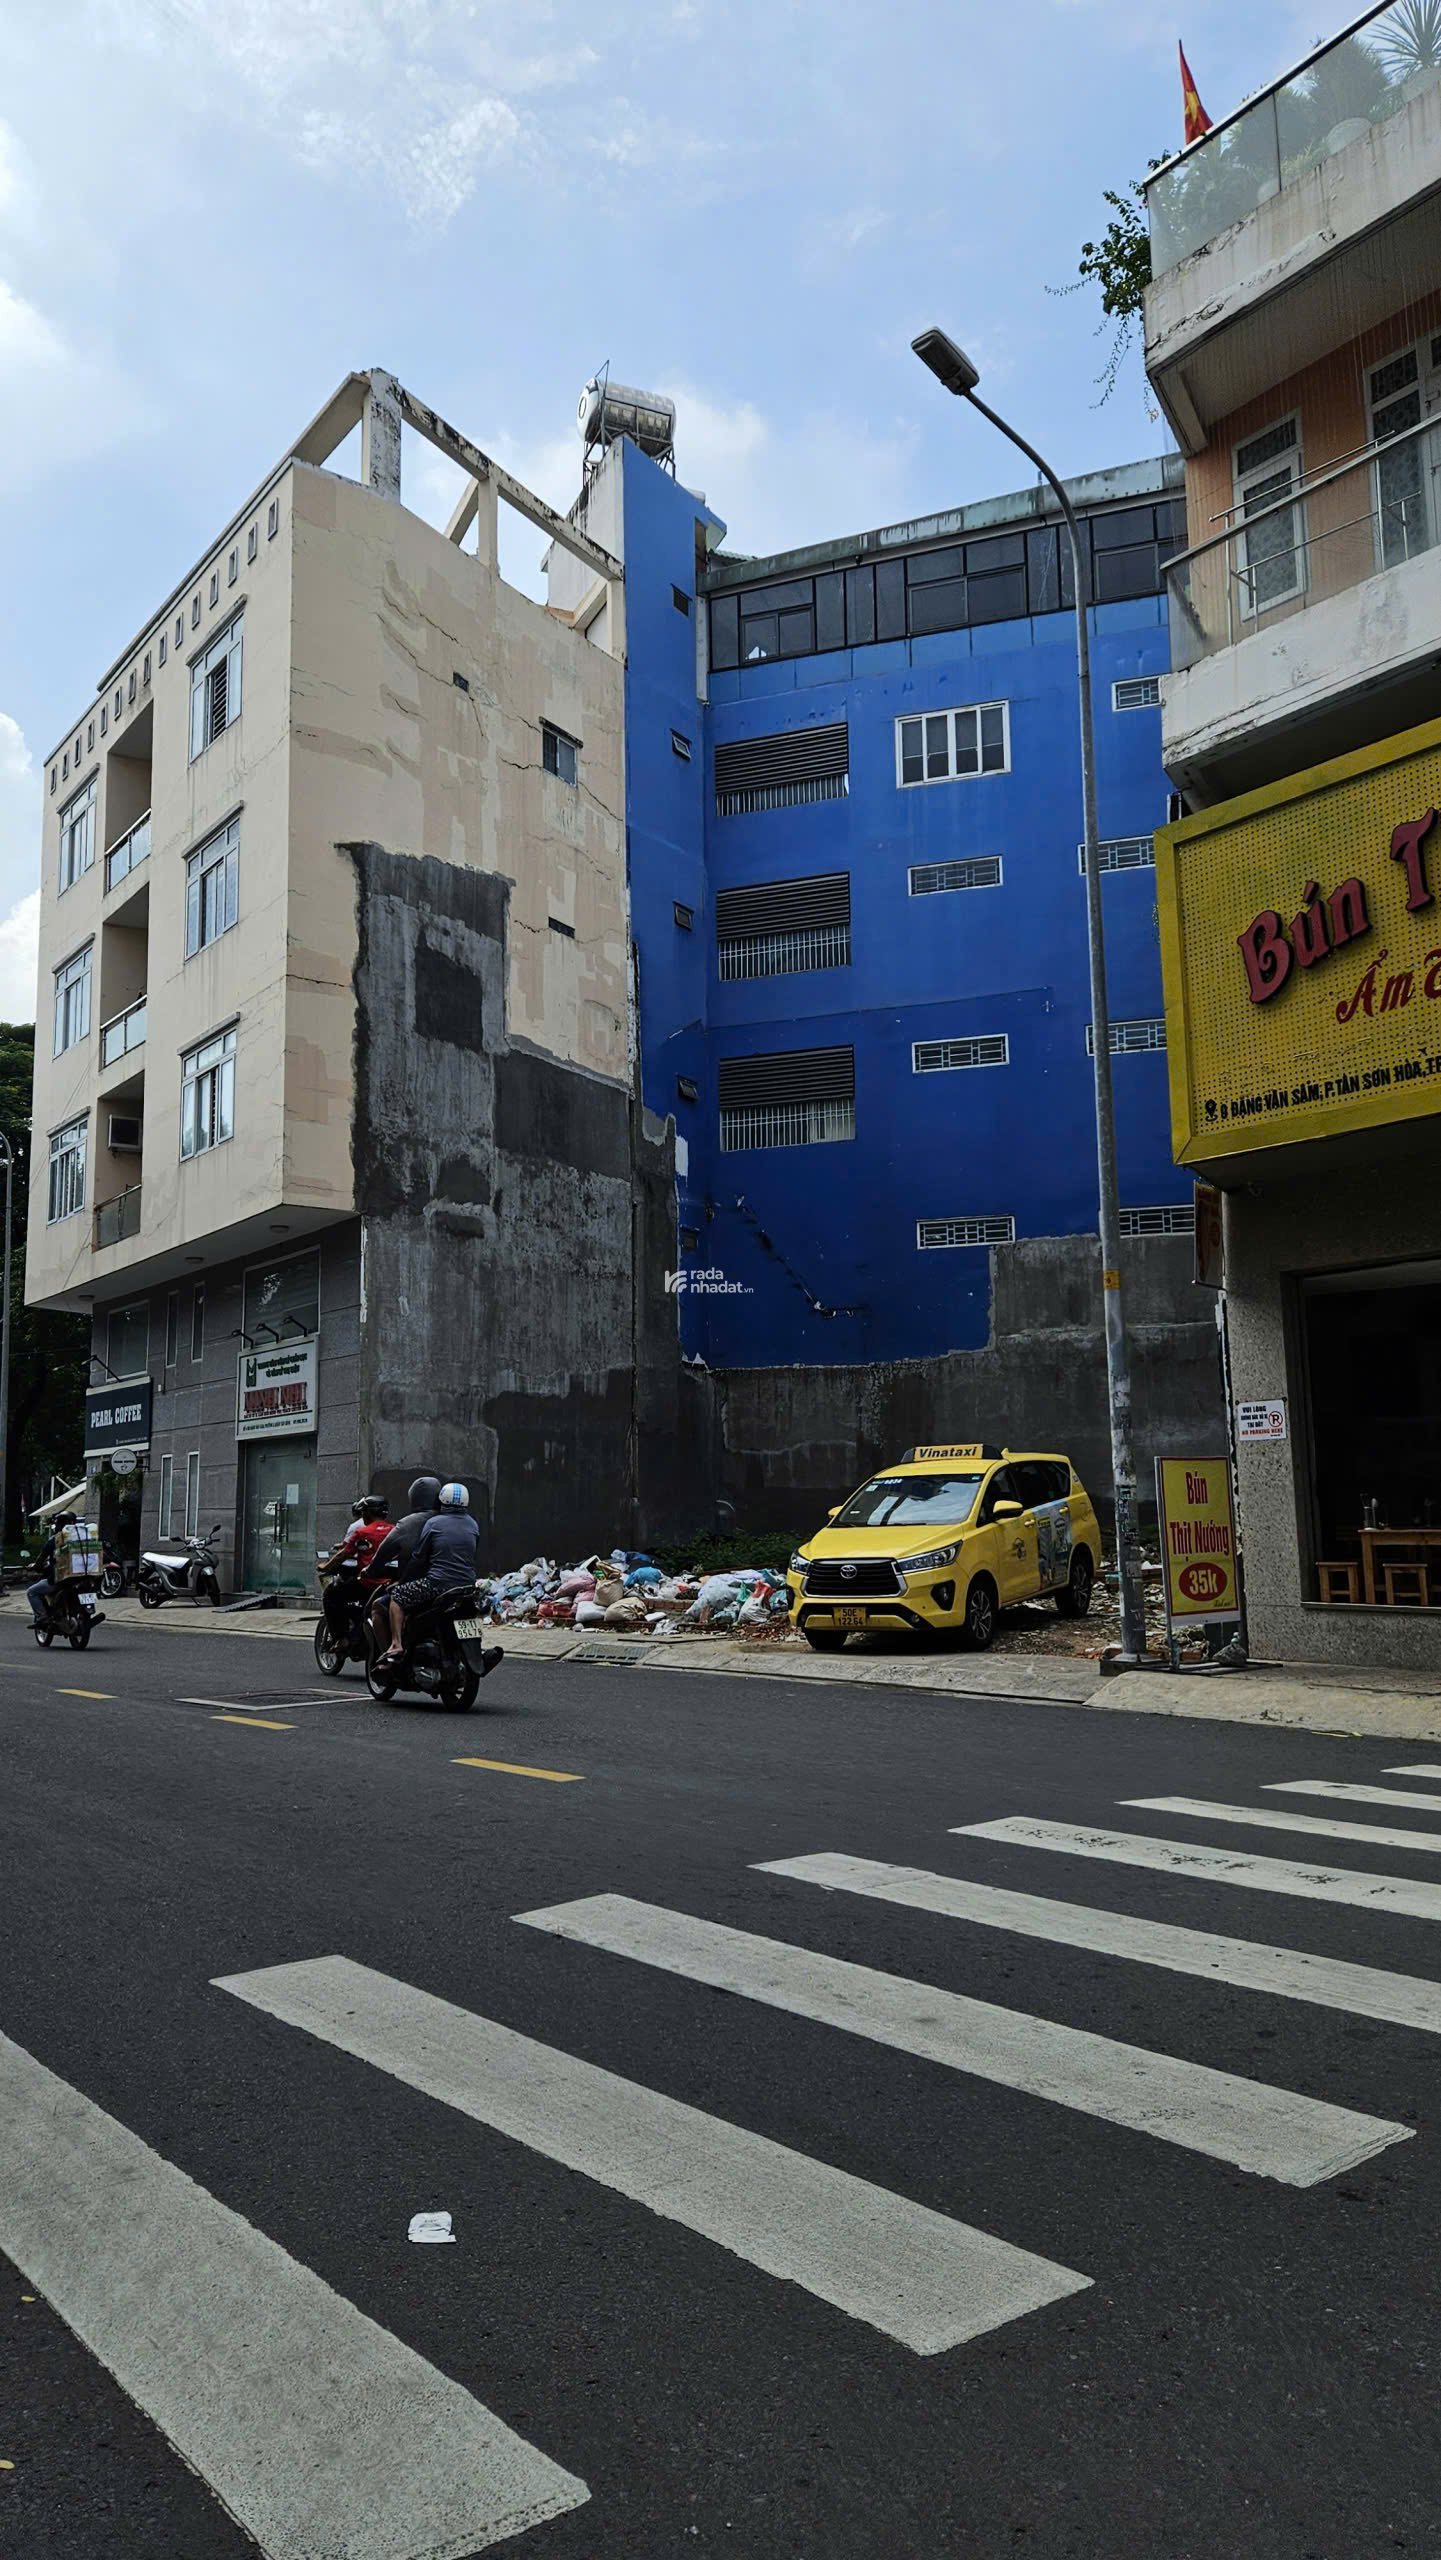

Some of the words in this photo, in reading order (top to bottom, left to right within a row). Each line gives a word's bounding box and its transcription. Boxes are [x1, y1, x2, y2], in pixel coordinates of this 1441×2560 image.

[1236, 877, 1372, 1004] Bún
[1336, 949, 1415, 1024] Ẩm
[1362, 1067, 1391, 1090] SƠN
[91, 1409, 113, 1429] PEARL
[114, 1404, 142, 1425] COFFEE
[919, 1446, 977, 1459] Vinataxi
[1185, 1471, 1208, 1505] Bún
[1170, 1521, 1192, 1562] Thịt
[1194, 1520, 1229, 1556] Nướng
[1189, 1570, 1218, 1595] 35k
